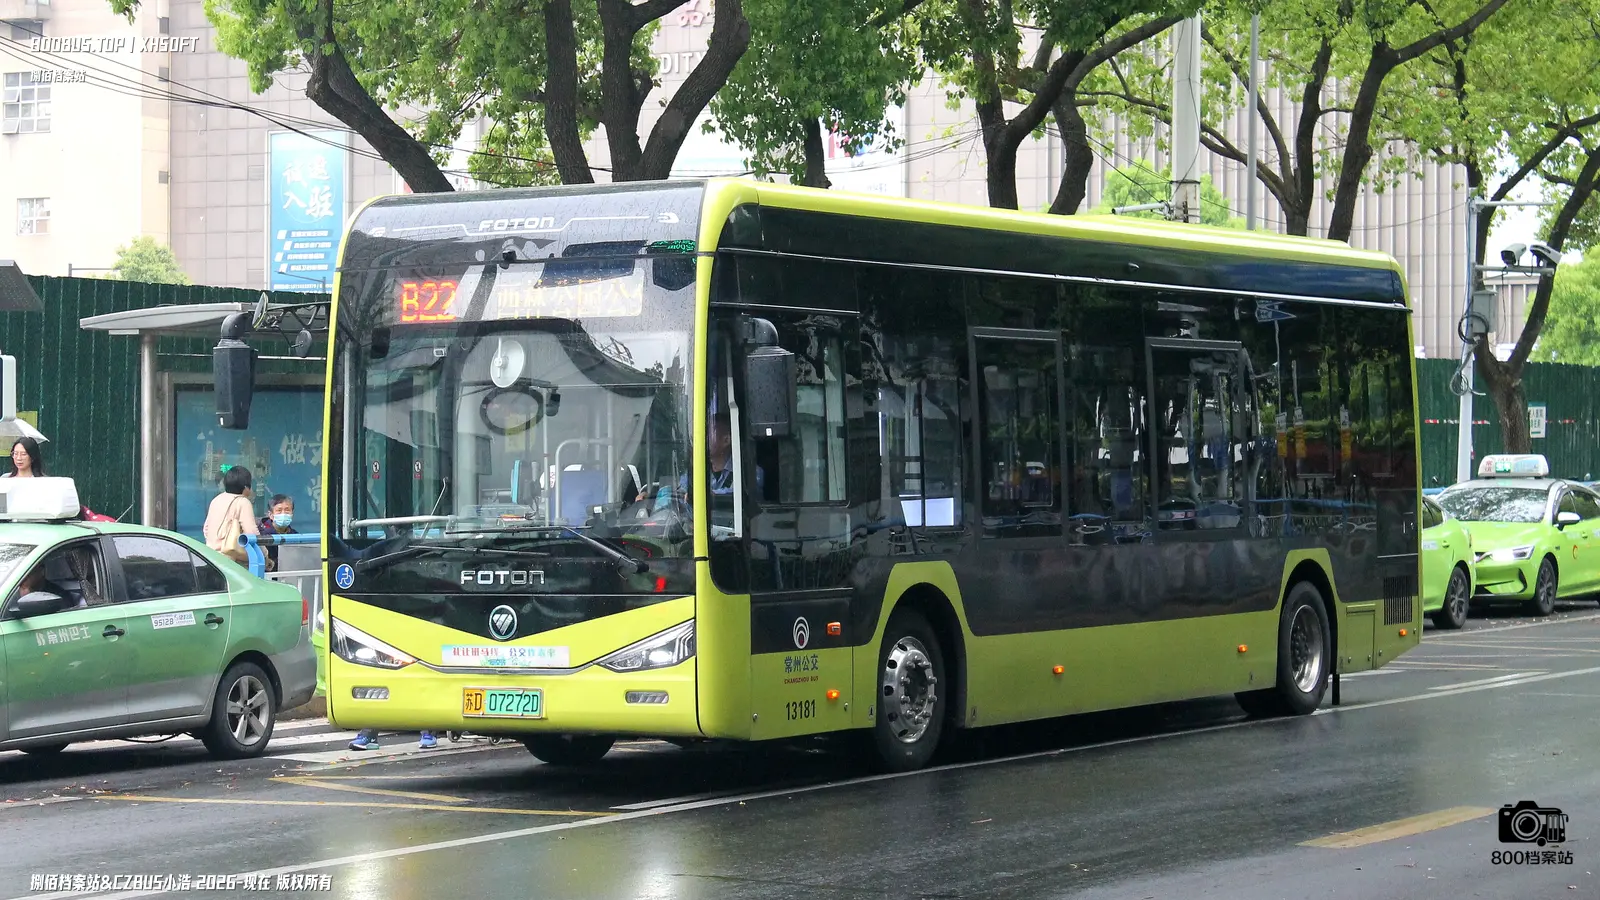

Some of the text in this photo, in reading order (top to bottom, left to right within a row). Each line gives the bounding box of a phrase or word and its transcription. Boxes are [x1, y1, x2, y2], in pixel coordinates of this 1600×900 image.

[479, 216, 555, 232] FOTON
[401, 281, 457, 322] B22
[460, 569, 545, 585] FOTON
[154, 617, 174, 627] 95128
[47, 625, 91, 644] 常州巴士
[784, 653, 819, 674] 常州公交
[786, 699, 816, 720] 13181
